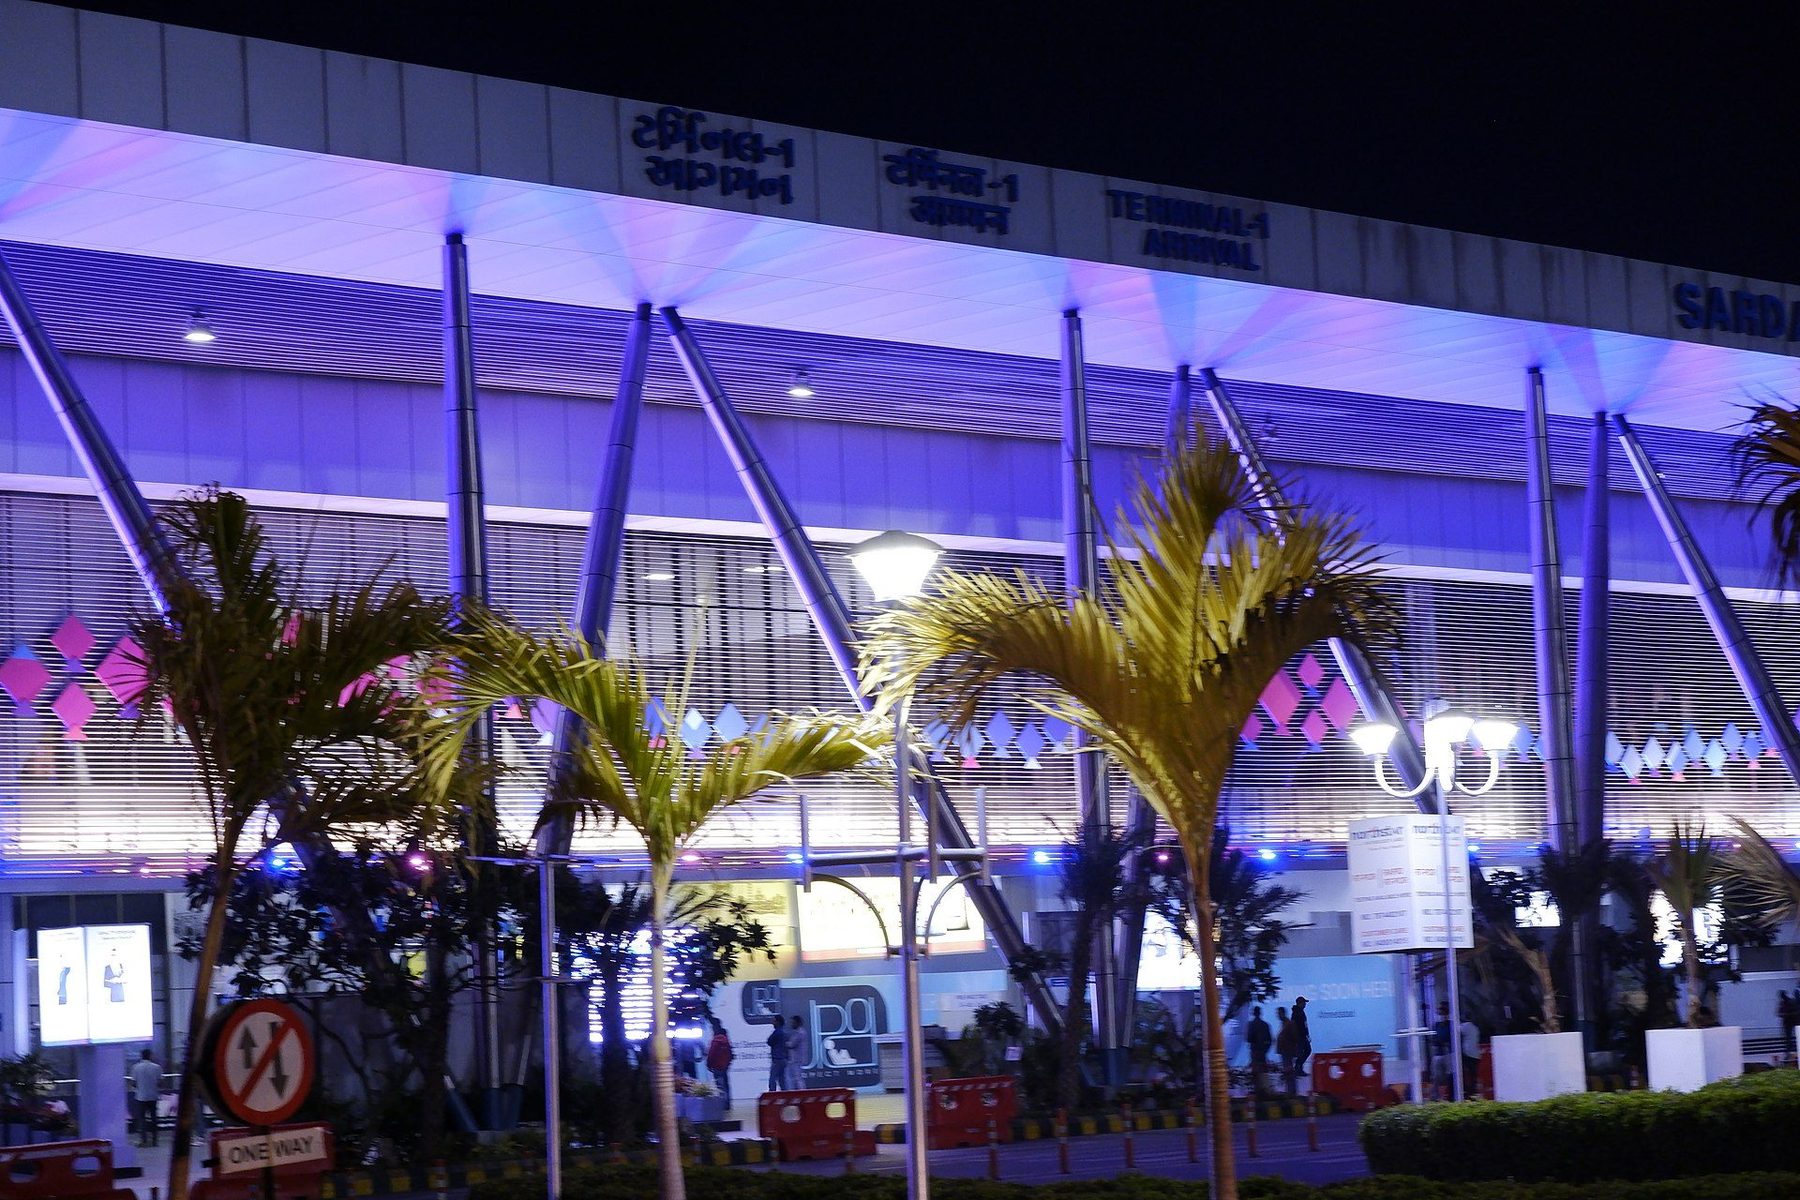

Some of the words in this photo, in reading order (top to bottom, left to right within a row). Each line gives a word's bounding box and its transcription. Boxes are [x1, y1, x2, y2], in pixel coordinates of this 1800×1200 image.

[1143, 228, 1261, 271] ARRIVAL
[229, 1142, 270, 1164] ONE
[273, 1136, 314, 1158] WAY
